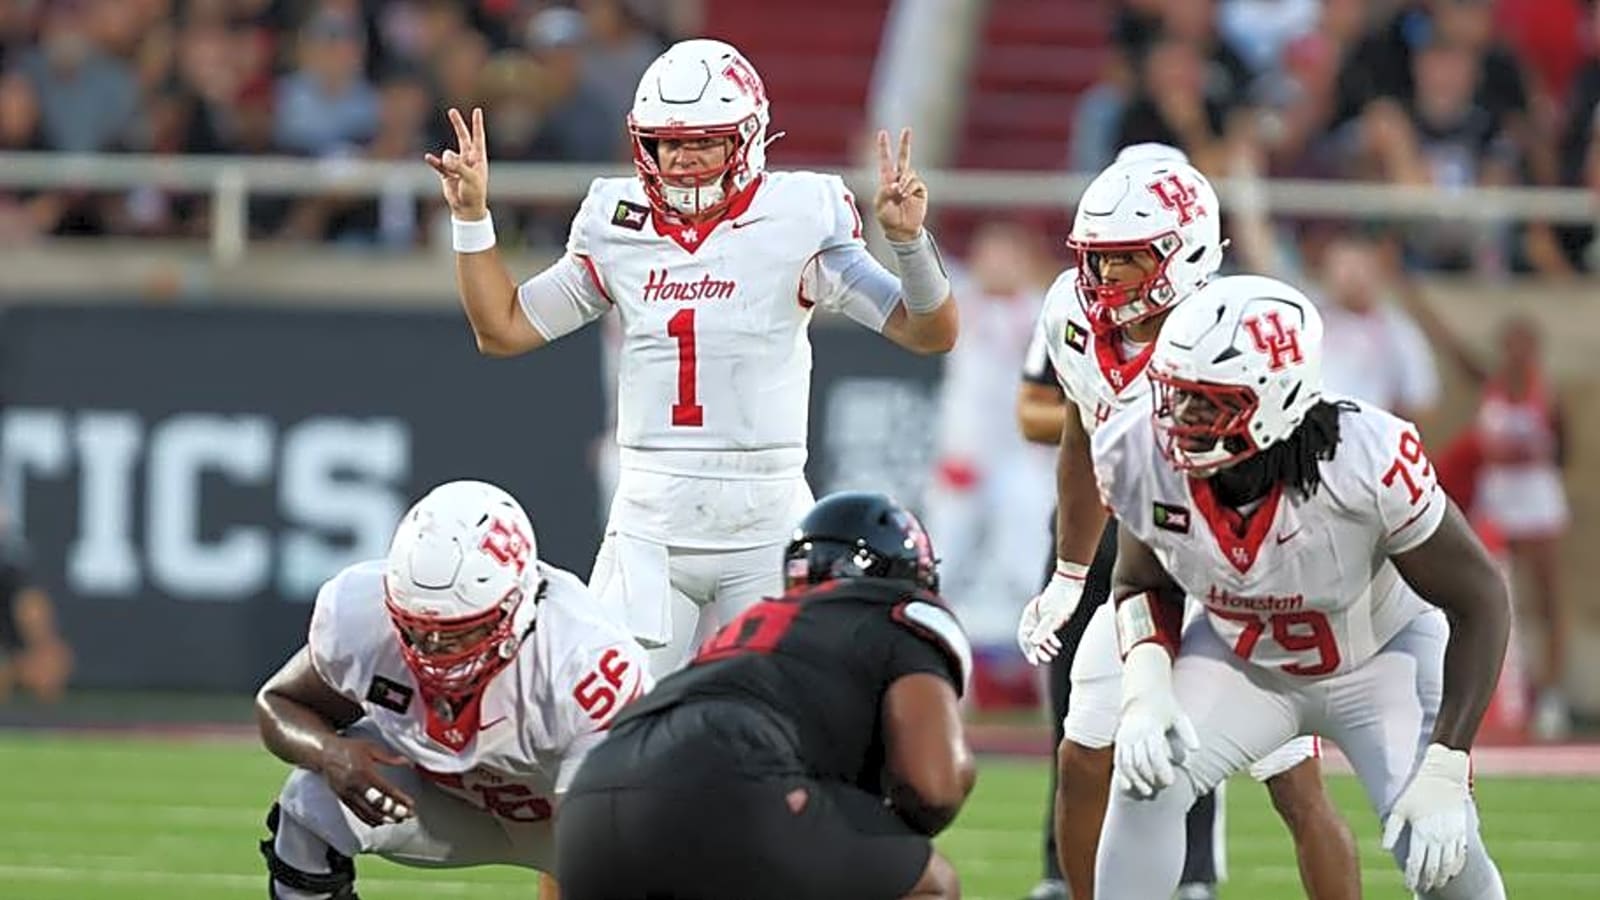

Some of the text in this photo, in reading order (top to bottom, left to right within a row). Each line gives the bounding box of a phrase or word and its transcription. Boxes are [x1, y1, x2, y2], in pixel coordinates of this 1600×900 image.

[643, 269, 736, 301] Houston
[667, 308, 704, 427] 1
[1243, 310, 1304, 372] UH
[1206, 584, 1304, 611] Houston
[1204, 604, 1342, 676] 79
